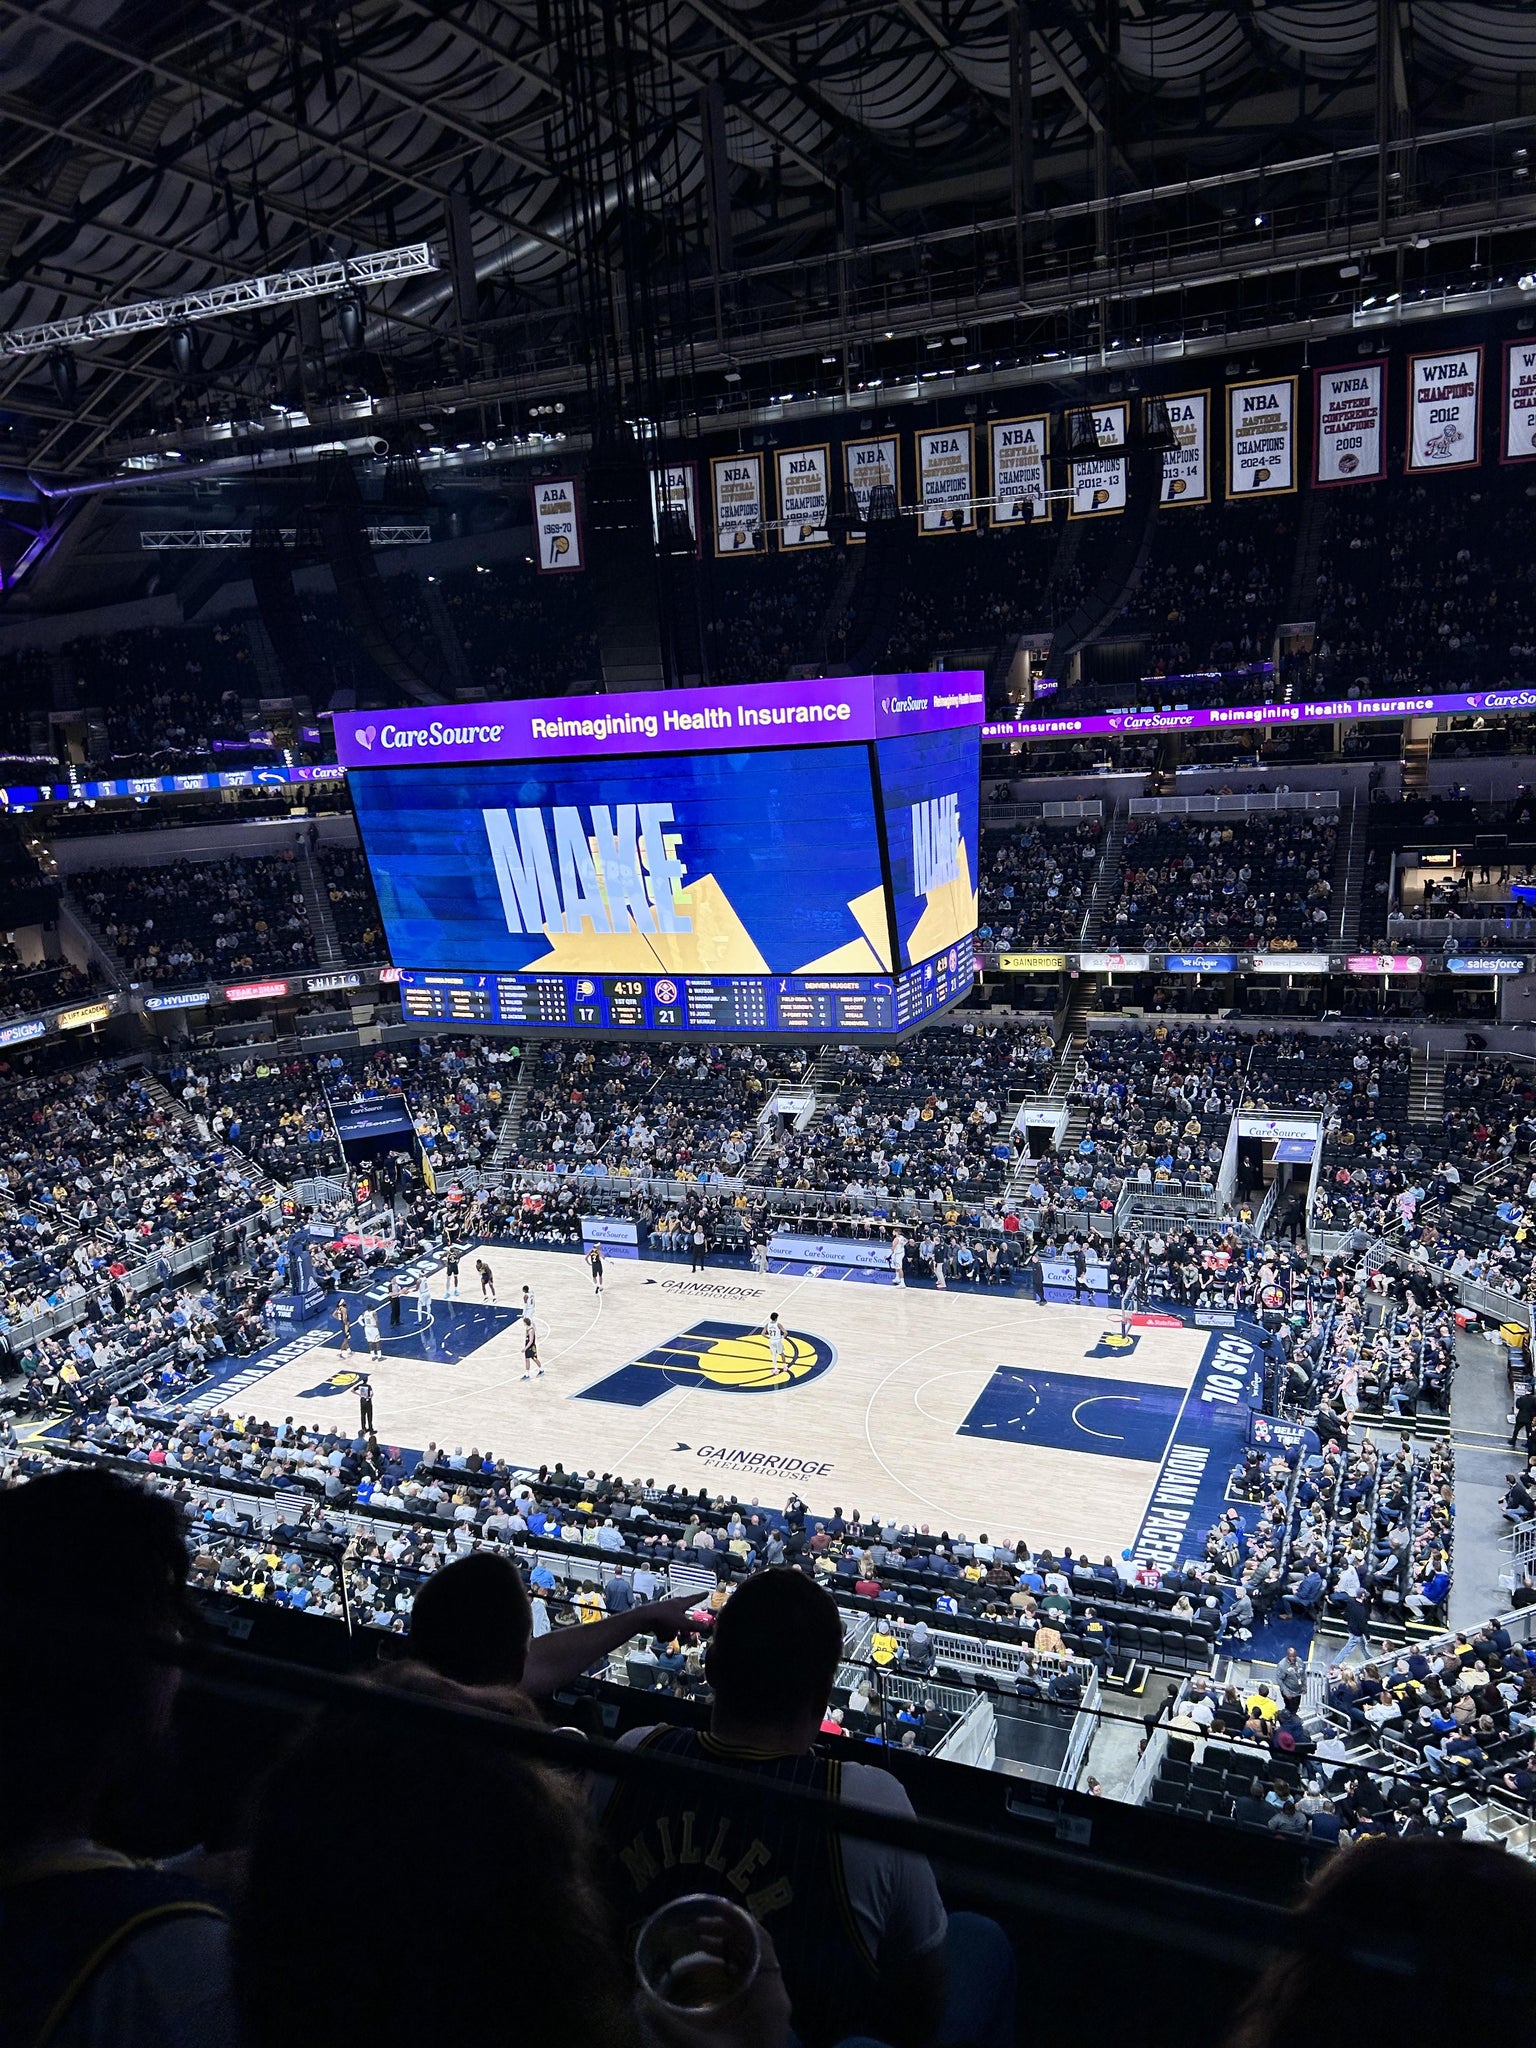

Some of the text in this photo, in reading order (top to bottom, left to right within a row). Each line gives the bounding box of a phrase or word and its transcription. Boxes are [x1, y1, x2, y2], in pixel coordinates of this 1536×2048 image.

[1423, 362, 1468, 381] WNBA
[1331, 377, 1368, 394] WNBA
[1418, 382, 1474, 403] CHAMPIONS
[1243, 394, 1279, 412] NBA
[1329, 398, 1371, 411] EASTERN
[1167, 406, 1194, 422] BA
[1242, 413, 1281, 427] EASTERN
[1322, 407, 1378, 424] CONFERENCE
[1430, 406, 1459, 424] 2012
[1236, 422, 1287, 438] CONFERENCE
[1324, 420, 1375, 435] CHAMPIONS
[1002, 429, 1035, 446] NBA
[1336, 437, 1362, 451] 2009
[931, 439, 959, 454] NBA
[1000, 445, 1038, 457] CENTRAL
[1237, 437, 1284, 455] CHAMPIONS
[857, 450, 885, 464] NBA
[1000, 456, 1039, 469] DIVISION
[1164, 449, 1199, 465] AMPIONS
[1241, 456, 1281, 468] 2024-25
[790, 460, 816, 473] NBA
[1077, 459, 1121, 476] CHAMPIONS
[724, 468, 750, 481] NBA
[786, 475, 821, 485] CENTRAL
[999, 468, 1040, 484] CHAMPIONS
[721, 483, 755, 493] CENTRAL
[787, 484, 821, 495] DIVISION
[926, 478, 966, 494] CHAMPIONS
[1000, 484, 1040, 496] 2003-04
[543, 489, 567, 501] ABA
[786, 495, 824, 510] CHAMPIONS
[721, 504, 758, 518] CHAMPIONS
[544, 522, 571, 534] 1969-70
[890, 696, 928, 714] CareSource
[1485, 691, 1536, 706] CareSo
[1210, 698, 1433, 722] Reimagining Health Insurance
[532, 700, 851, 741] Reimagining Health Insurance
[1124, 715, 1193, 728] CareSource
[381, 722, 501, 748] CareSource
[982, 721, 1082, 736] ealth Insurance
[312, 766, 344, 778] CareS
[136, 784, 156, 792] 9/15
[184, 780, 198, 788] 0/0
[228, 777, 243, 786] 3/7
[73, 789, 81, 798] 4
[911, 793, 960, 896] MAKE
[483, 803, 693, 934] MAKE
[1014, 958, 1062, 967] GAINBRIDGE
[1192, 958, 1218, 970] Kroger
[1467, 958, 1524, 970] salesforce
[379, 968, 401, 981] LUC
[307, 976, 346, 989] SHIFT
[614, 982, 642, 995] 4:19
[226, 983, 286, 997] STEAK SHAKE
[164, 992, 210, 1004] HYUNDAI
[68, 1005, 107, 1020] LIFT ACADEMY
[579, 1008, 593, 1021] 17
[659, 1011, 675, 1023] 21
[1026, 1117, 1058, 1126] CareSour
[1249, 1127, 1306, 1137] CareSource
[357, 1186, 369, 1202] 24
[592, 1230, 628, 1239] CareSource
[768, 1247, 792, 1255] Source
[804, 1250, 846, 1260] CareSource
[856, 1254, 887, 1263] CareSou
[1048, 1273, 1095, 1284] CareSce
[661, 1279, 766, 1298] GAINBRIDGE
[666, 1288, 748, 1301] FIELDHOUSE
[276, 1304, 294, 1312] BELLE
[1198, 1318, 1233, 1326] CareSource
[256, 1329, 334, 1368] PACERS
[1201, 1374, 1243, 1405] OIL
[1274, 1426, 1306, 1437] BELLE
[696, 1445, 835, 1476] GAINBRIDGE
[703, 1459, 810, 1482] FIELDHOUSE
[1154, 1444, 1210, 1505] INDIANA
[1144, 1577, 1157, 1588] 15
[619, 1811, 793, 1921] MILLER
